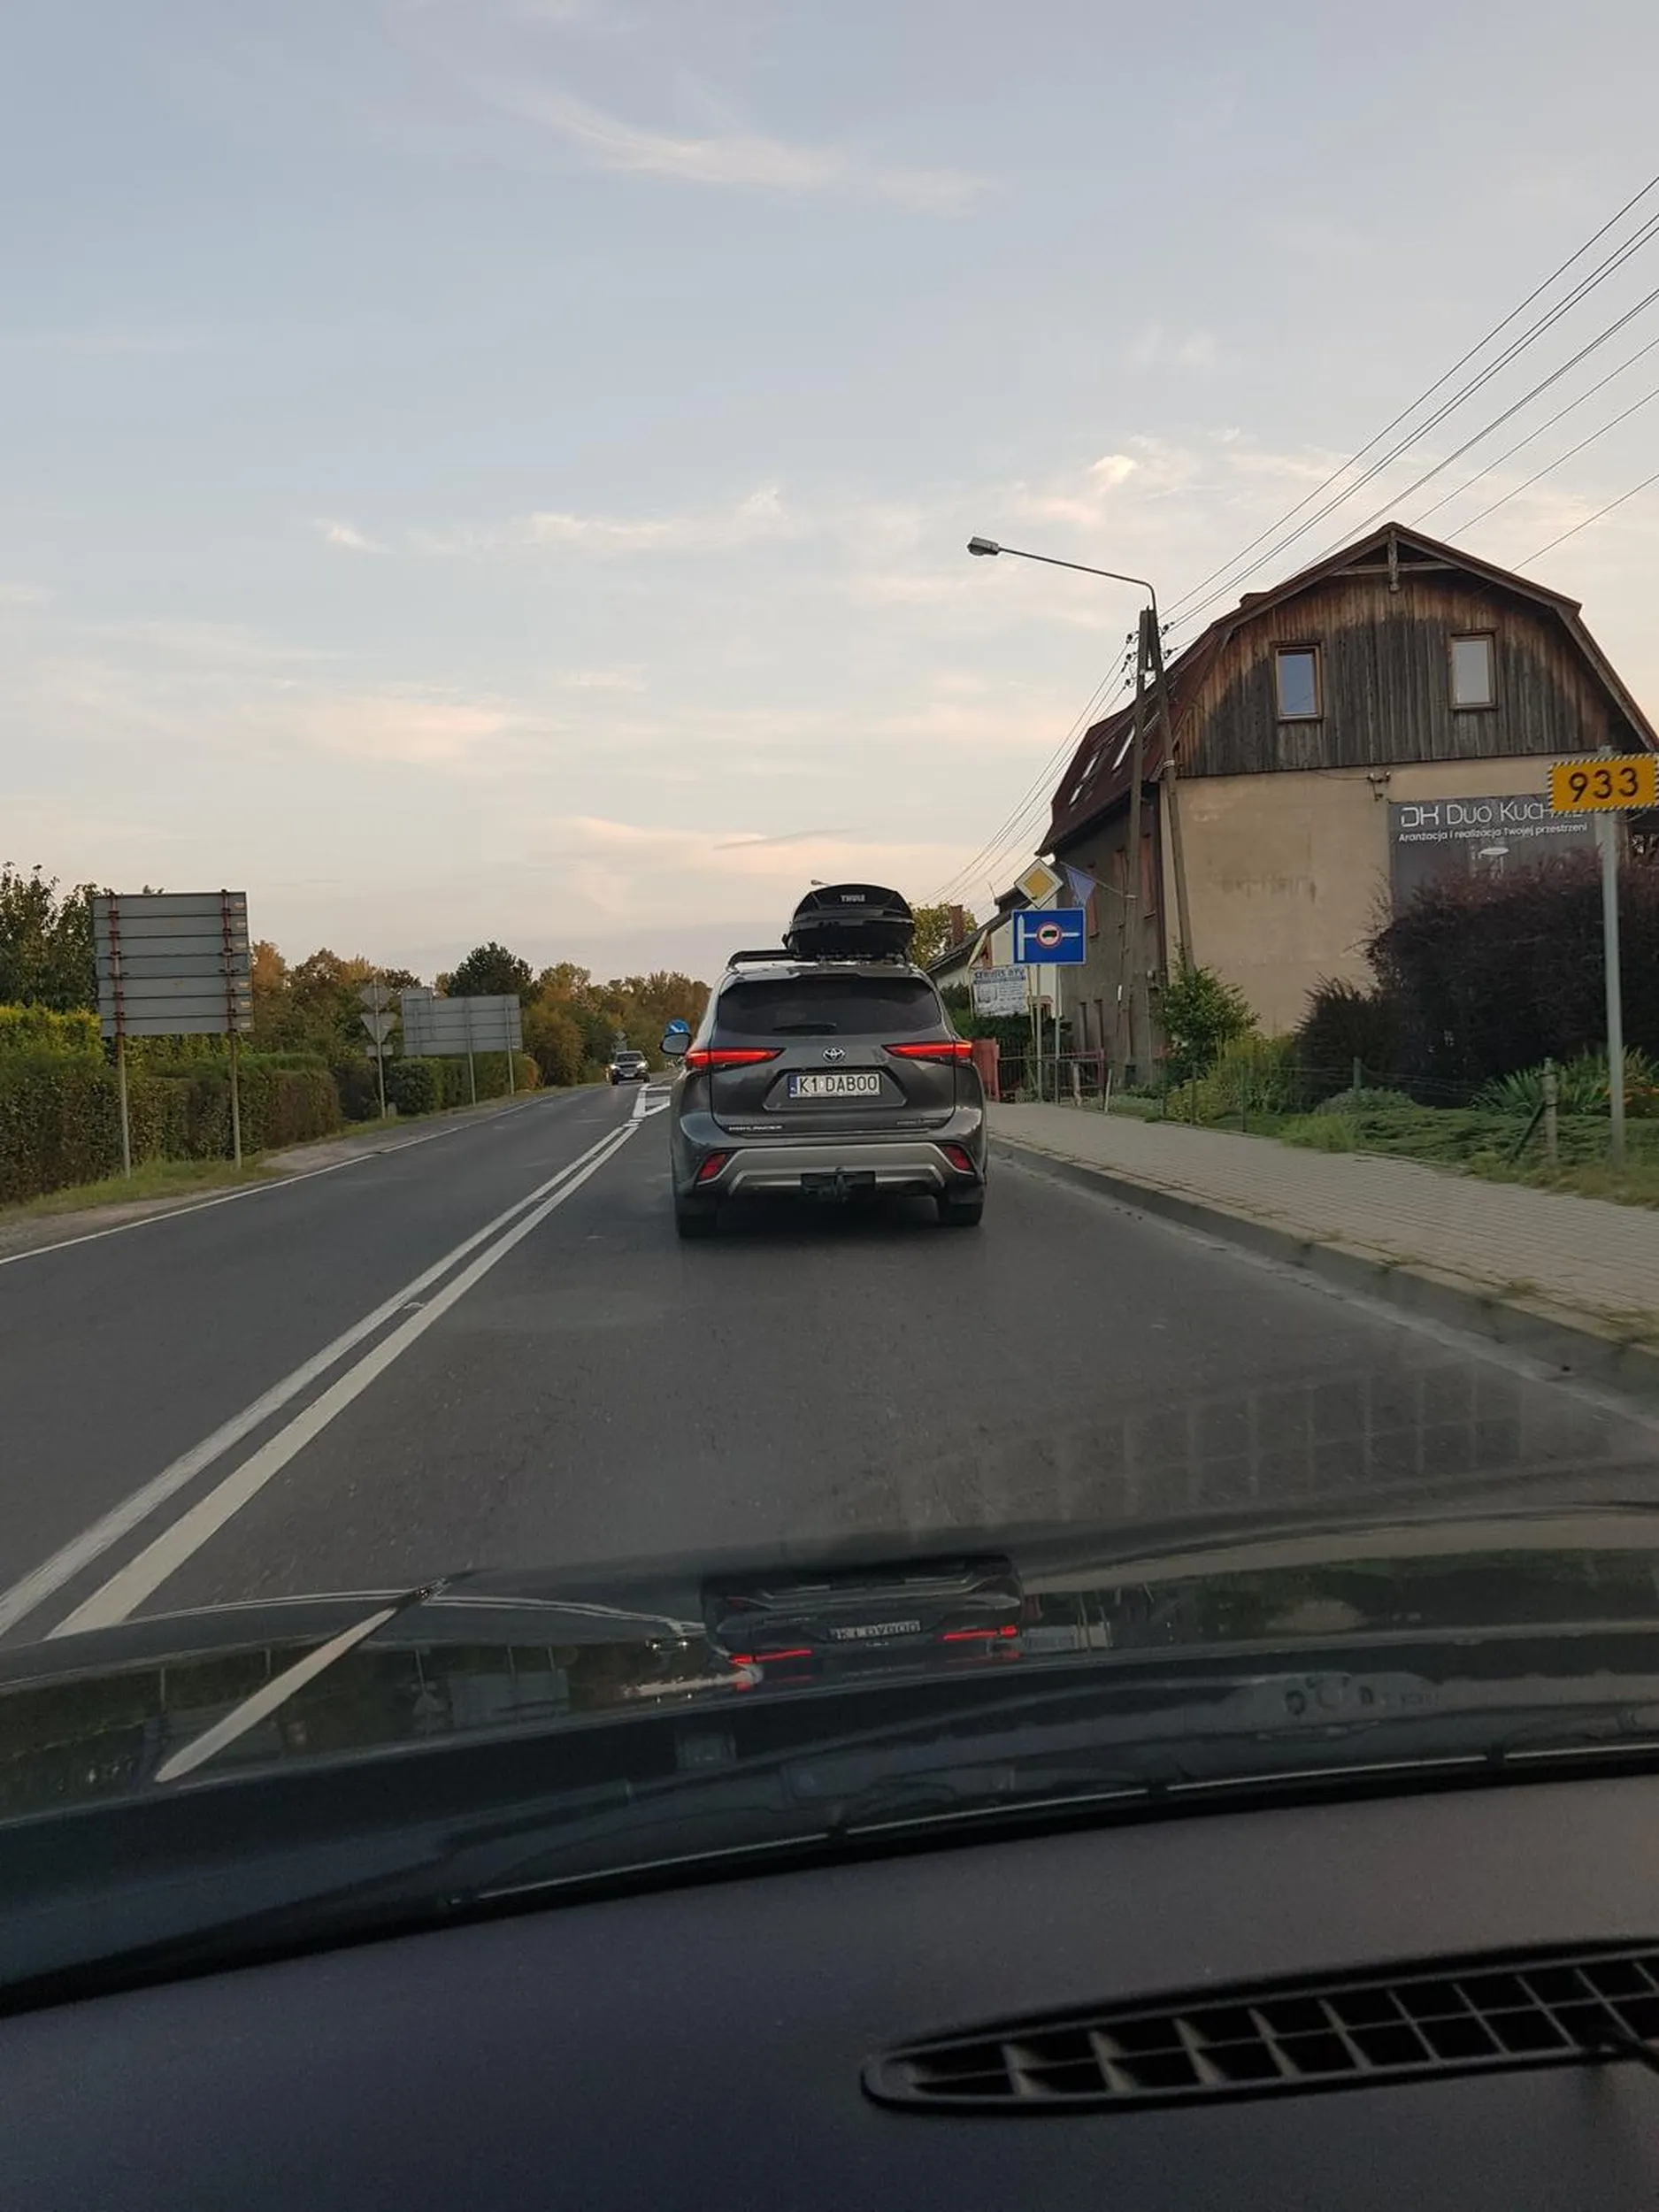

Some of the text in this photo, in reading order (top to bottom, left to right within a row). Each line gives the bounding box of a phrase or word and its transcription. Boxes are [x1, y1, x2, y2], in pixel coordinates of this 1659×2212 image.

[1569, 767, 1639, 803] 933
[1454, 827, 1502, 841] realizacja
[1534, 822, 1587, 836] przestrzeni
[799, 1077, 818, 1093] K1
